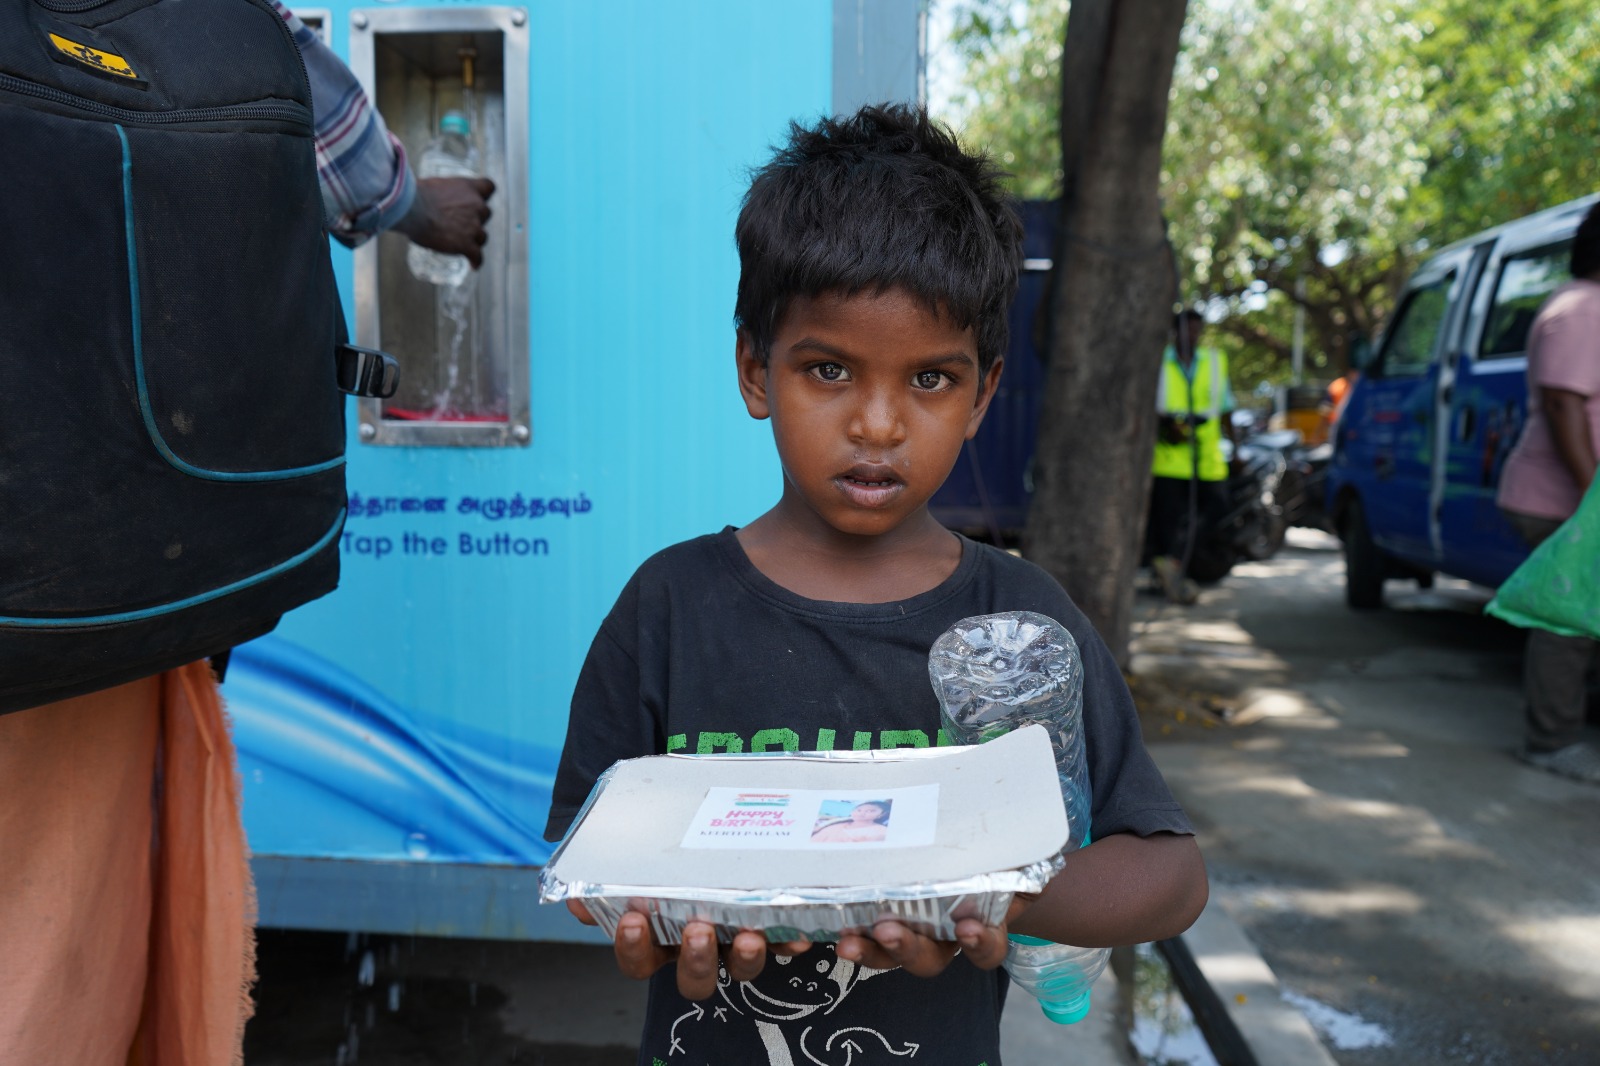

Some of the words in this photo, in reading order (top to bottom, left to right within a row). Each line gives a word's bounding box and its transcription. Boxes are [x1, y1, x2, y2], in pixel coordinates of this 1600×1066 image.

[348, 492, 446, 517] த்தானை
[457, 492, 591, 520] அழுத்தவும்
[342, 530, 393, 559] Tap
[402, 530, 448, 555] the
[459, 530, 549, 556] Button
[726, 810, 784, 818] Happy
